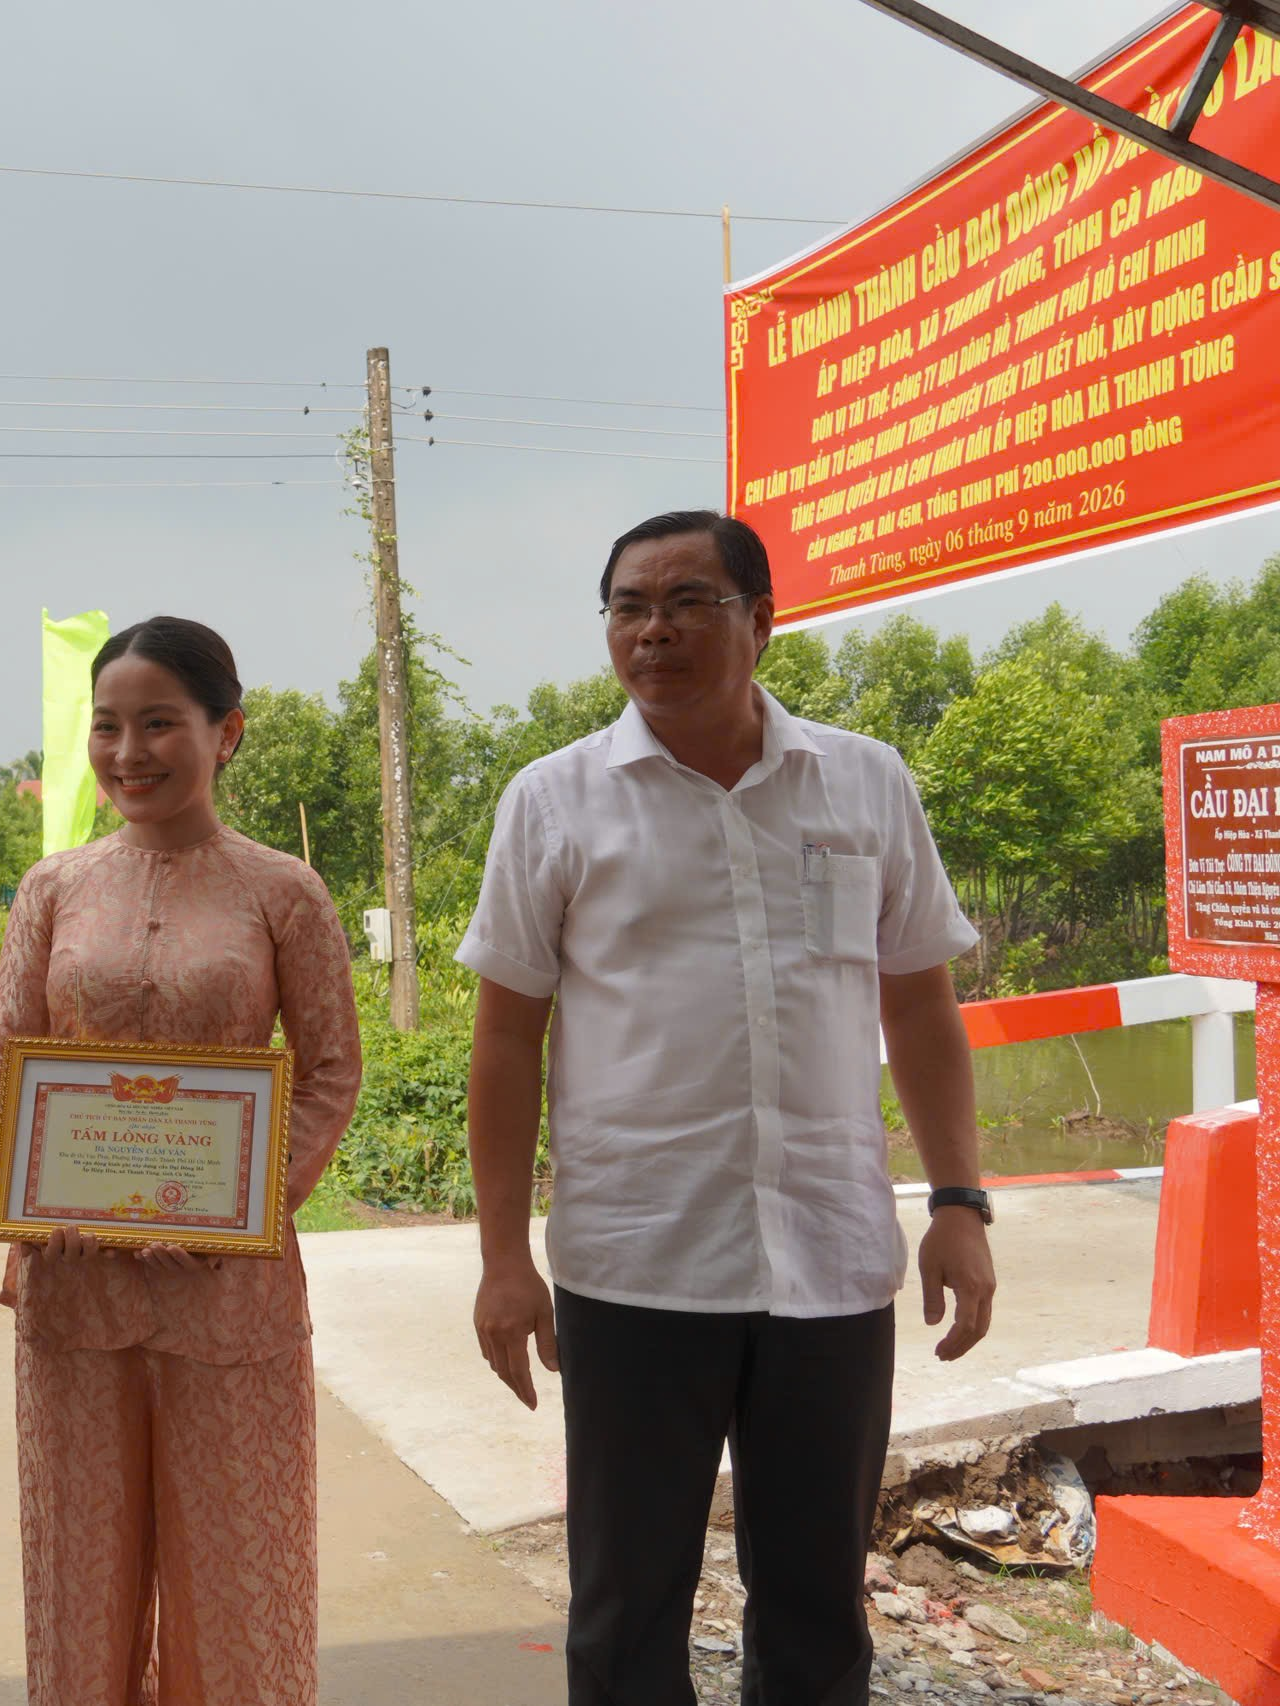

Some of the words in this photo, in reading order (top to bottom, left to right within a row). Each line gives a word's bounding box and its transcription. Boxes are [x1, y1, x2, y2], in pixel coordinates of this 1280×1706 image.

[768, 311, 786, 367] LỄ
[792, 297, 851, 358] KHÁNH
[854, 254, 915, 326] THÀNH
[922, 224, 960, 292] CẦU
[965, 203, 1000, 268] ĐẠI
[817, 359, 838, 398] ẤP
[841, 345, 876, 387] HIỆP
[879, 327, 915, 370] HÒA,
[918, 308, 939, 350] XÃ
[942, 277, 996, 337] THANH
[1054, 209, 1102, 270] TỈNH
[1110, 185, 1141, 238] CÀ
[1145, 165, 1203, 219] MAU
[835, 406, 847, 436] VỊ
[849, 396, 866, 428] TÀI
[891, 371, 922, 409] CÔNG
[923, 362, 938, 395] TY
[937, 351, 958, 388] ĐẠI
[1014, 293, 1059, 345] THÀNH
[1058, 266, 1091, 322] PHỐ
[1091, 254, 1115, 305] HỒ
[1118, 240, 1151, 291] CHÍ
[1153, 219, 1206, 275] MINH
[745, 478, 764, 506] CHỊ
[766, 470, 788, 500] LÂM
[790, 464, 806, 492] THỊ
[846, 436, 874, 471] CÙNG
[874, 421, 907, 459] NHÓM
[907, 405, 939, 445] THIỆN
[938, 382, 984, 431] NGUYỆN
[984, 363, 1020, 408] THIỆN
[1021, 351, 1044, 391] TÀI
[1045, 331, 1073, 380] KẾT
[1076, 316, 1107, 367] NỐI,
[1112, 306, 1147, 352] XÂY
[1151, 282, 1205, 337] DỰNG
[791, 502, 815, 535] TẶNG
[816, 488, 846, 523] CHÍNH
[846, 471, 878, 514] QUYỀN
[877, 466, 893, 499] VÀ
[891, 459, 908, 494] BÀ
[908, 452, 933, 487] CON
[932, 436, 965, 477] NHÂN
[965, 425, 992, 464] DÂN
[993, 410, 1012, 452] ẤP
[1015, 401, 1047, 445] HIỆP
[1051, 389, 1084, 432] HÒA
[1088, 376, 1110, 419] XÃ
[1114, 355, 1175, 409] THANH
[1181, 334, 1234, 386] TÙNG
[825, 526, 858, 554] NGANG
[877, 510, 895, 537] DÀI
[897, 501, 923, 529] 45M,
[926, 487, 957, 520] TỔNG
[961, 477, 992, 509] KINH
[996, 464, 1019, 498] PHÍ
[1023, 434, 1125, 490] 200.000.000
[1131, 416, 1183, 456] ĐỒNG
[829, 557, 866, 586] Thanh
[870, 549, 906, 573] Tùng,
[909, 537, 941, 566] ngày
[945, 528, 964, 553] 06
[968, 518, 1014, 548] tháng
[1018, 509, 1029, 533] 9
[1034, 500, 1073, 529] năm
[1079, 480, 1126, 516] 2026
[1190, 773, 1228, 818] CẦU
[1233, 787, 1269, 824] ĐẠI
[1196, 749, 1226, 763] NAM
[1230, 744, 1252, 760] MÔ
[1257, 746, 1267, 758] A
[1244, 853, 1252, 872] TY
[71, 1125, 107, 1141] TẤM
[112, 1128, 159, 1143] LÒNG
[164, 1131, 212, 1146] VÀNG
